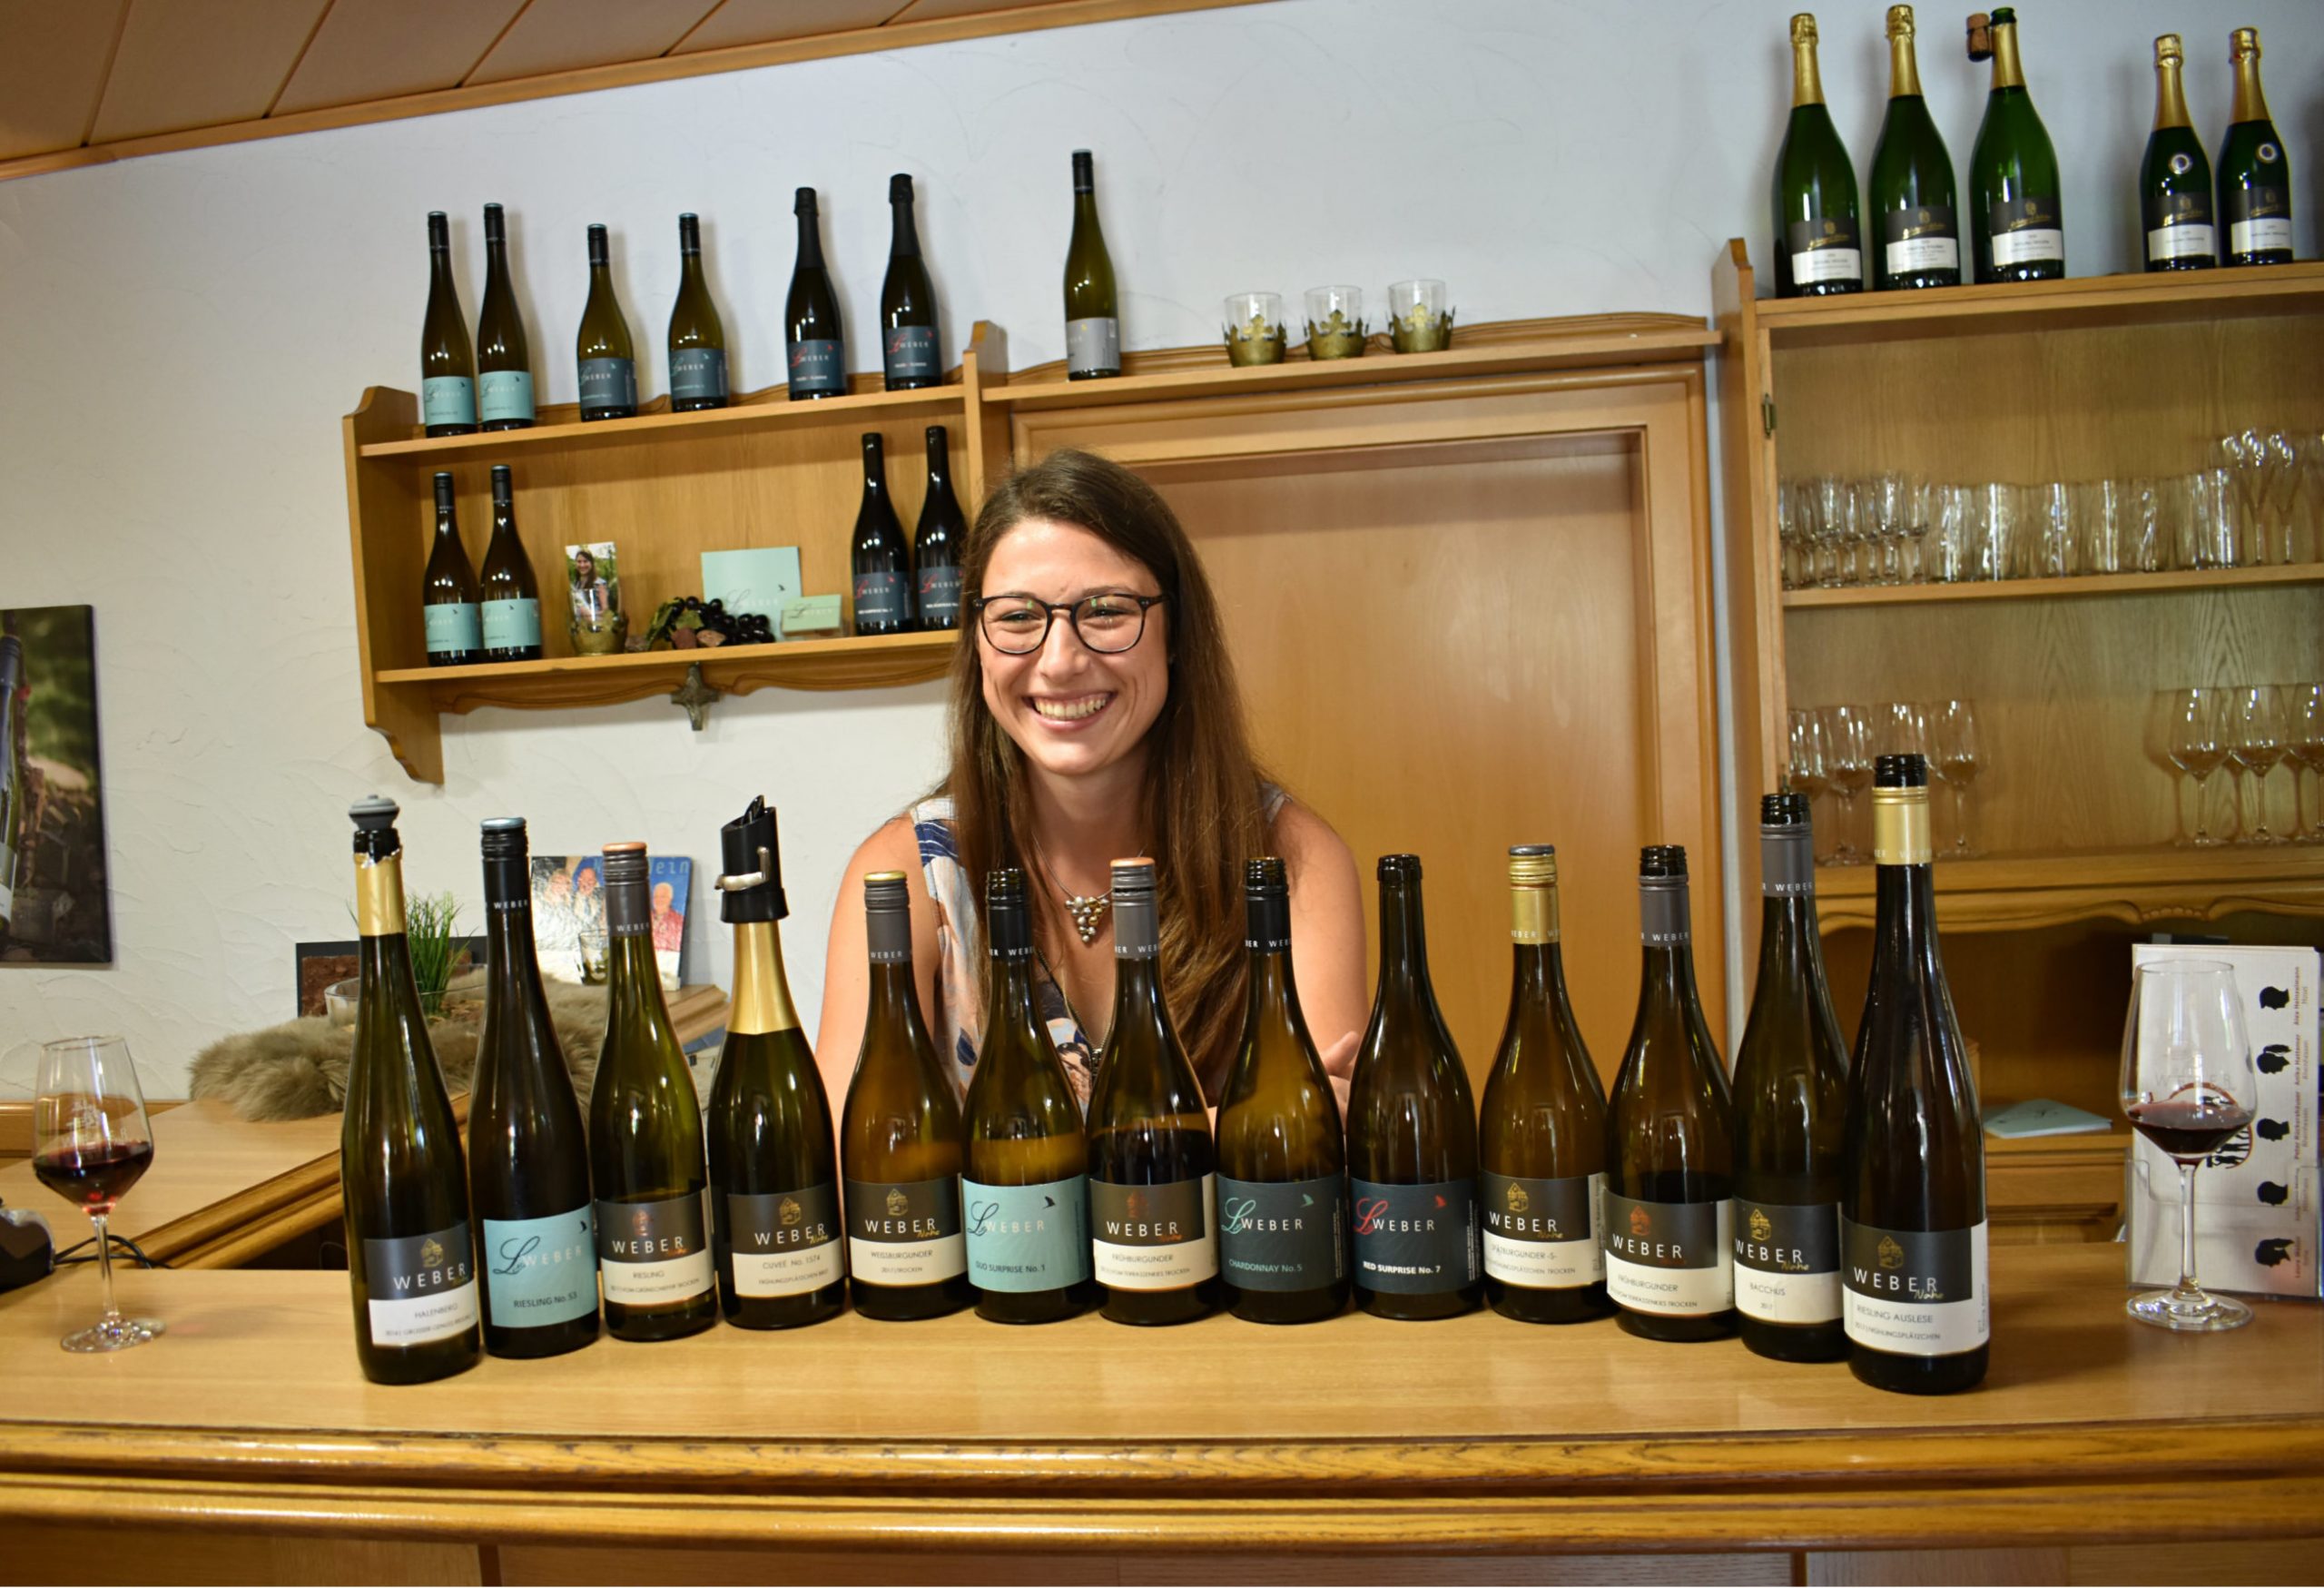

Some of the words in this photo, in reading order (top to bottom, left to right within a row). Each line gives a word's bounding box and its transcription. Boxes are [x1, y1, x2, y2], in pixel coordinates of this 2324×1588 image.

[871, 951, 902, 959] WEBER
[865, 1218, 936, 1234] WEBER
[984, 1219, 1044, 1233] WEBER
[1106, 1220, 1178, 1237] WEBER
[1241, 1218, 1303, 1231] WEBER
[1372, 1218, 1434, 1232] WEBER
[1489, 1210, 1558, 1232] WEBER
[754, 1222, 825, 1246] WEBER
[612, 1235, 684, 1254] WEBER
[1612, 1233, 1682, 1259] WEBER
[1735, 1238, 1803, 1264] WEBER
[522, 1245, 582, 1266] WEBER
[989, 1263, 1023, 1274] SURPRISE
[1228, 1258, 1279, 1272] CHARDONNAY
[1363, 1260, 1376, 1270] RED
[1377, 1264, 1416, 1275] SURPRISE
[1418, 1266, 1433, 1274] No.
[1435, 1264, 1441, 1272] 7
[393, 1262, 466, 1290] WEBER
[1854, 1266, 1937, 1292] WEBER
[1749, 1281, 1786, 1297] BACCHUS
[513, 1297, 552, 1308] RIESLING
[1856, 1304, 1891, 1321] RIESLING
[1893, 1313, 1933, 1324] AUSLESE
